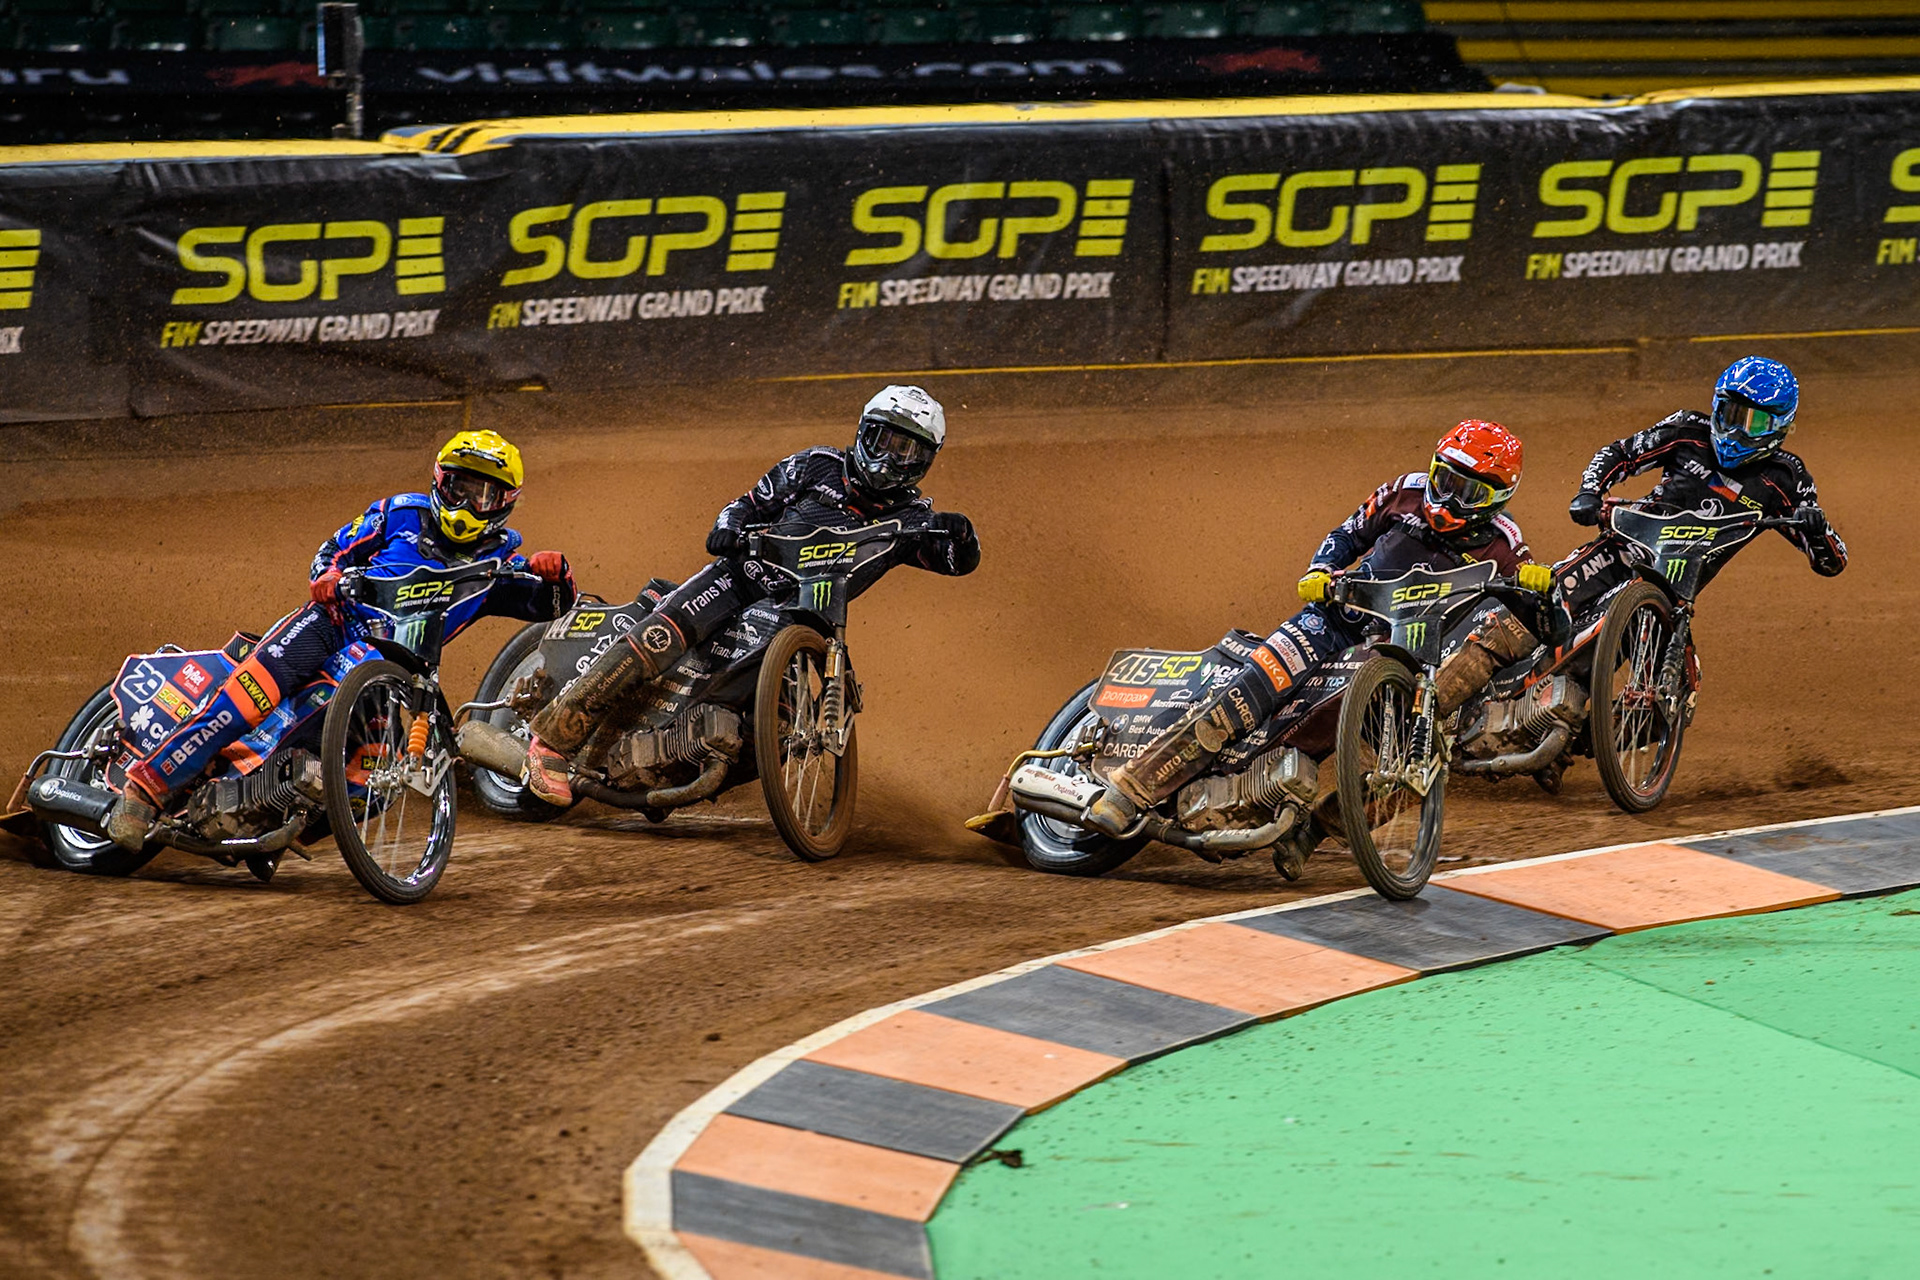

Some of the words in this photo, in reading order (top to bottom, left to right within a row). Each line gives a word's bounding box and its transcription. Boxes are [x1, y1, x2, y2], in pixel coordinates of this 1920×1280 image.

[1525, 253, 1562, 279] FIM
[1563, 249, 1669, 278] SPEEDWAY
[1671, 244, 1748, 272] GRAND
[1751, 241, 1804, 269] PRIX
[1876, 238, 1917, 265] FIM
[838, 281, 879, 309] FIM
[880, 275, 989, 306] SPEEDWAY
[989, 273, 1062, 300] GRAND
[1063, 272, 1114, 299] PRIX
[1192, 268, 1230, 294] FIM
[1232, 262, 1342, 293] SPEEDWAY
[1344, 259, 1413, 286] GRAND
[1415, 256, 1464, 283] PRIX
[487, 302, 522, 329] FIM
[521, 294, 637, 326] SPEEDWAY
[638, 289, 713, 319] GRAND
[714, 286, 767, 315] PRIX
[160, 322, 201, 348] FIM
[200, 317, 317, 345] SPEEDWAY
[317, 313, 389, 342] GRAND
[390, 309, 440, 338] PRIX
[804, 559, 826, 568] SPEEDWAY
[681, 586, 721, 616] Trans
[714, 572, 733, 592] MF
[1396, 601, 1420, 610] SPEEDWAY
[571, 612, 606, 631] SGP
[1108, 653, 1168, 685] 415
[1155, 656, 1203, 678] SGP
[1256, 648, 1285, 687] KUKA
[1325, 676, 1346, 687] TOP
[1101, 691, 1144, 705] pompax
[1128, 725, 1145, 735] Best
[1132, 715, 1154, 724] BMW
[171, 710, 233, 765] BETARD
